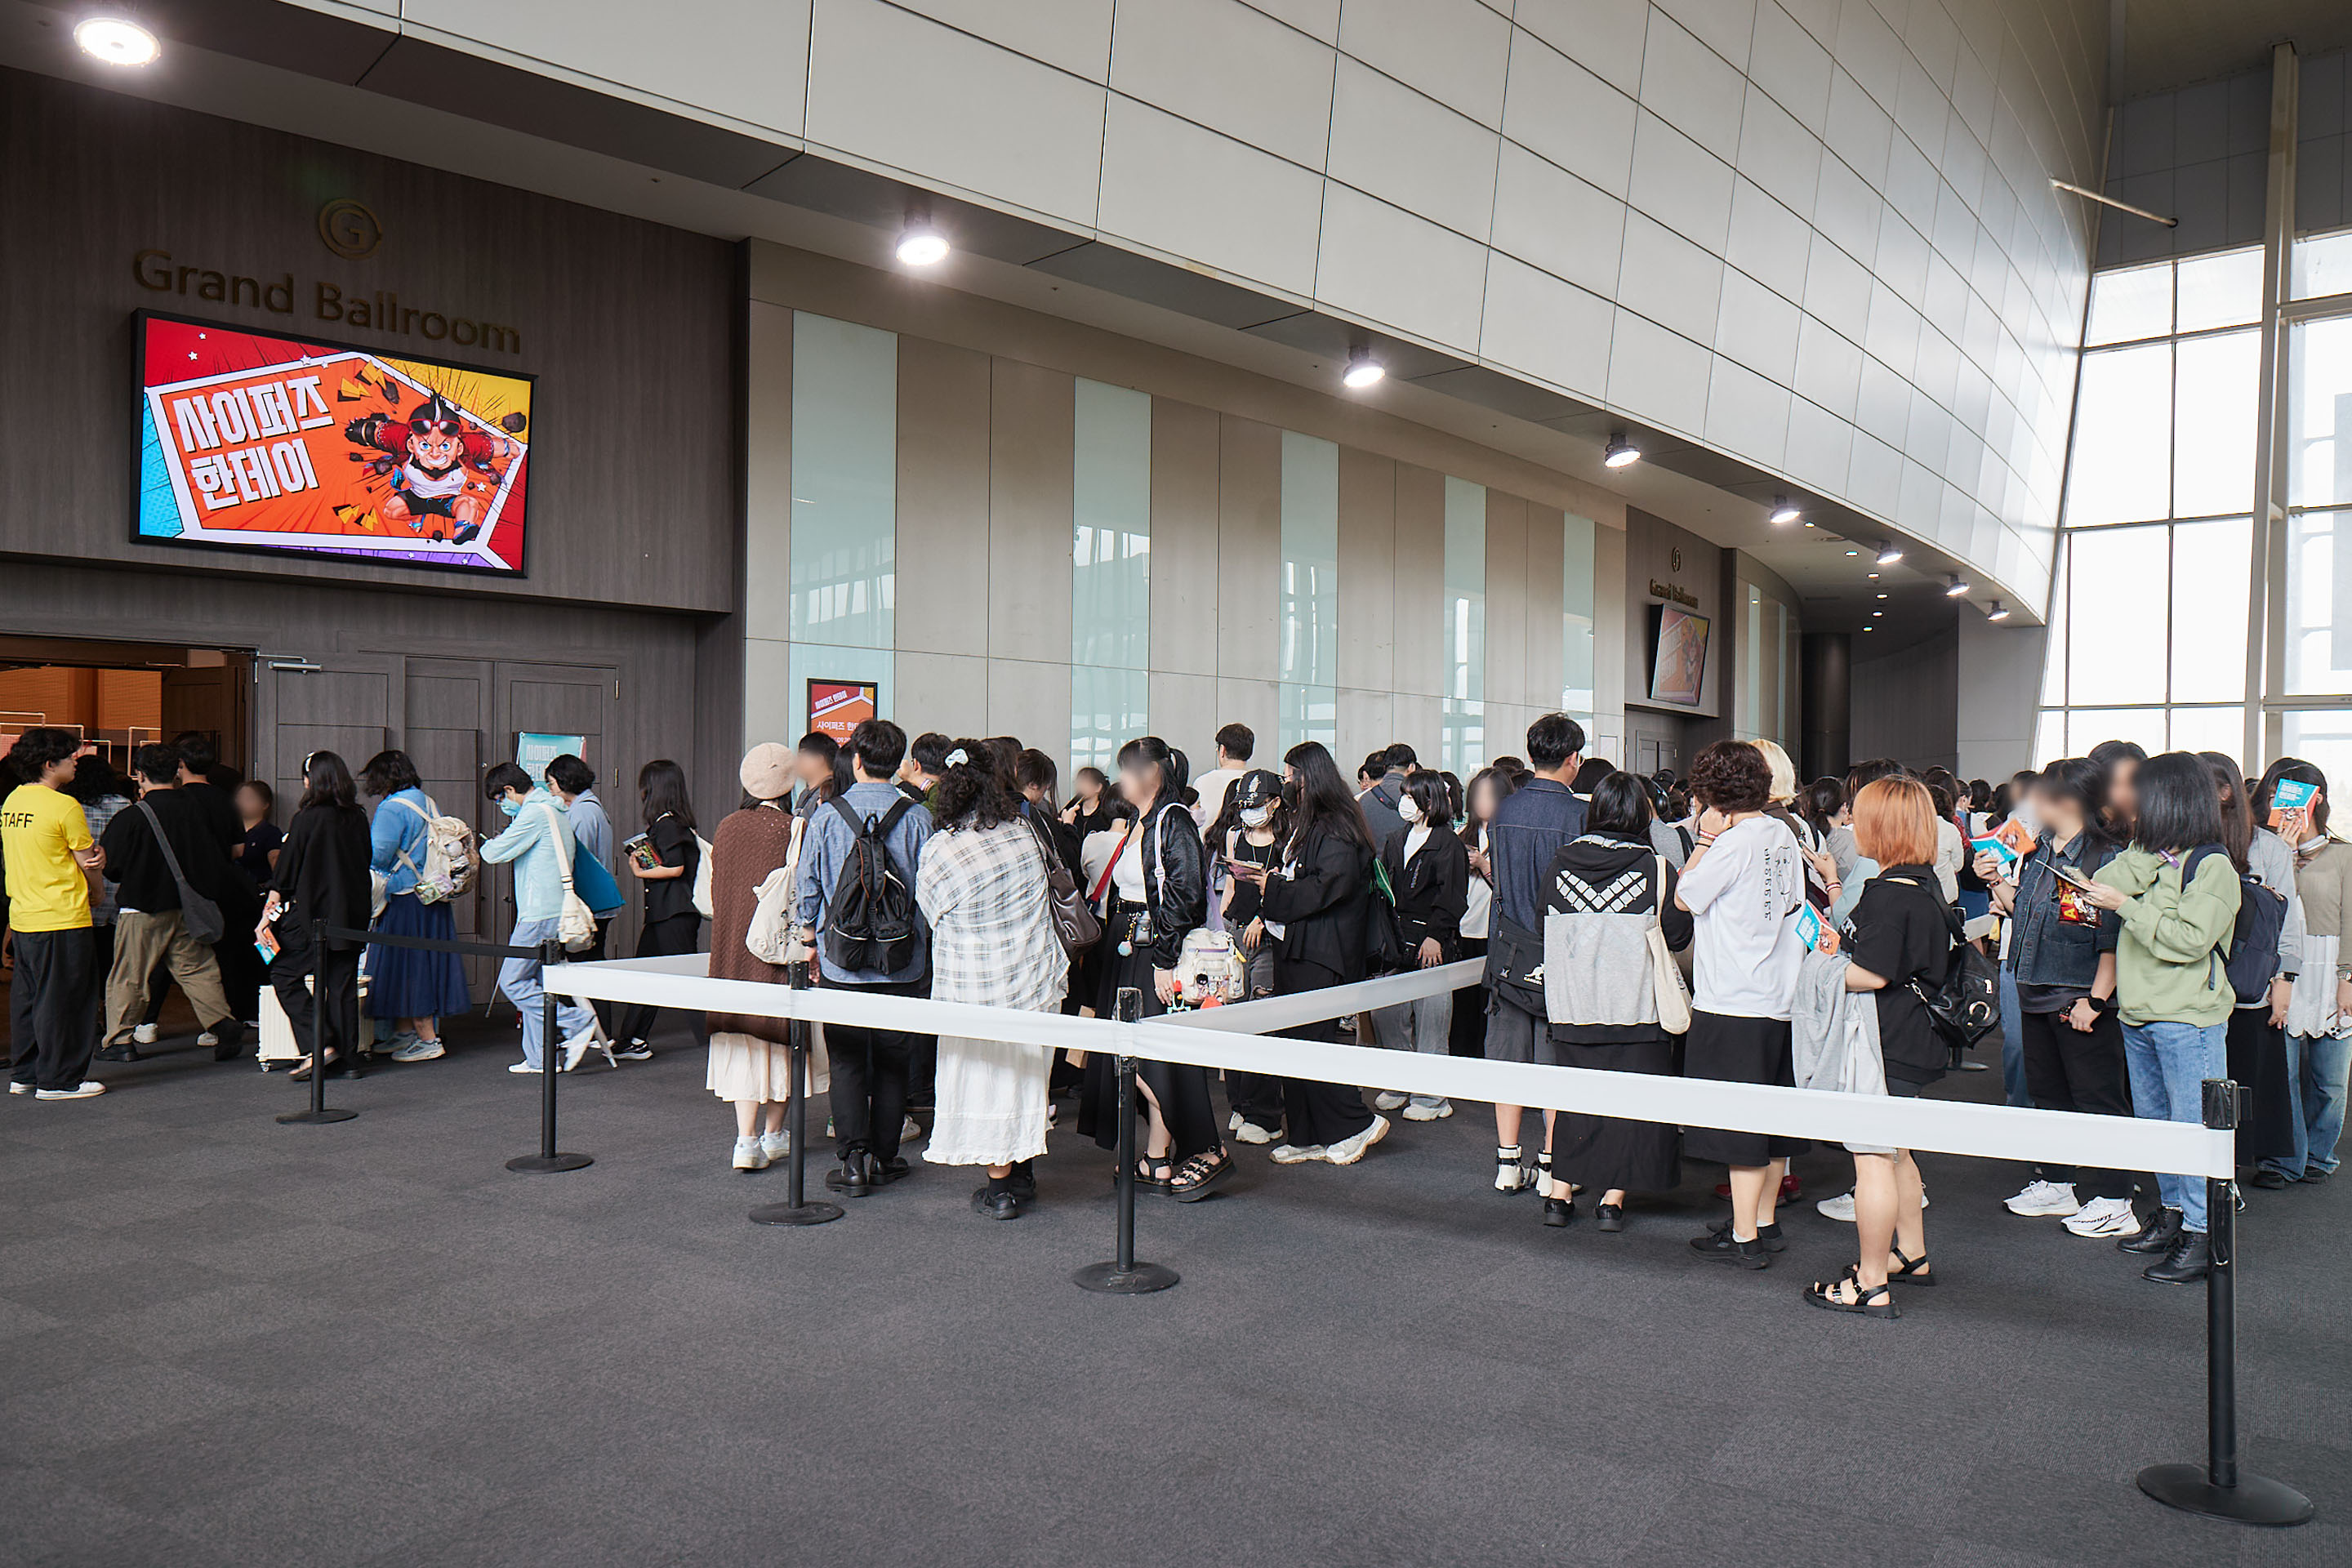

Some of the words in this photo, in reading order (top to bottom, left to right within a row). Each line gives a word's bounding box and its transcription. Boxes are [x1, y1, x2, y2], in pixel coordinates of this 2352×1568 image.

[133, 249, 295, 314] Grand
[315, 281, 521, 354] Ballroom
[172, 375, 335, 453] 사이퍼즈
[189, 438, 320, 511] 한데이
[0, 812, 34, 828] TAFF
